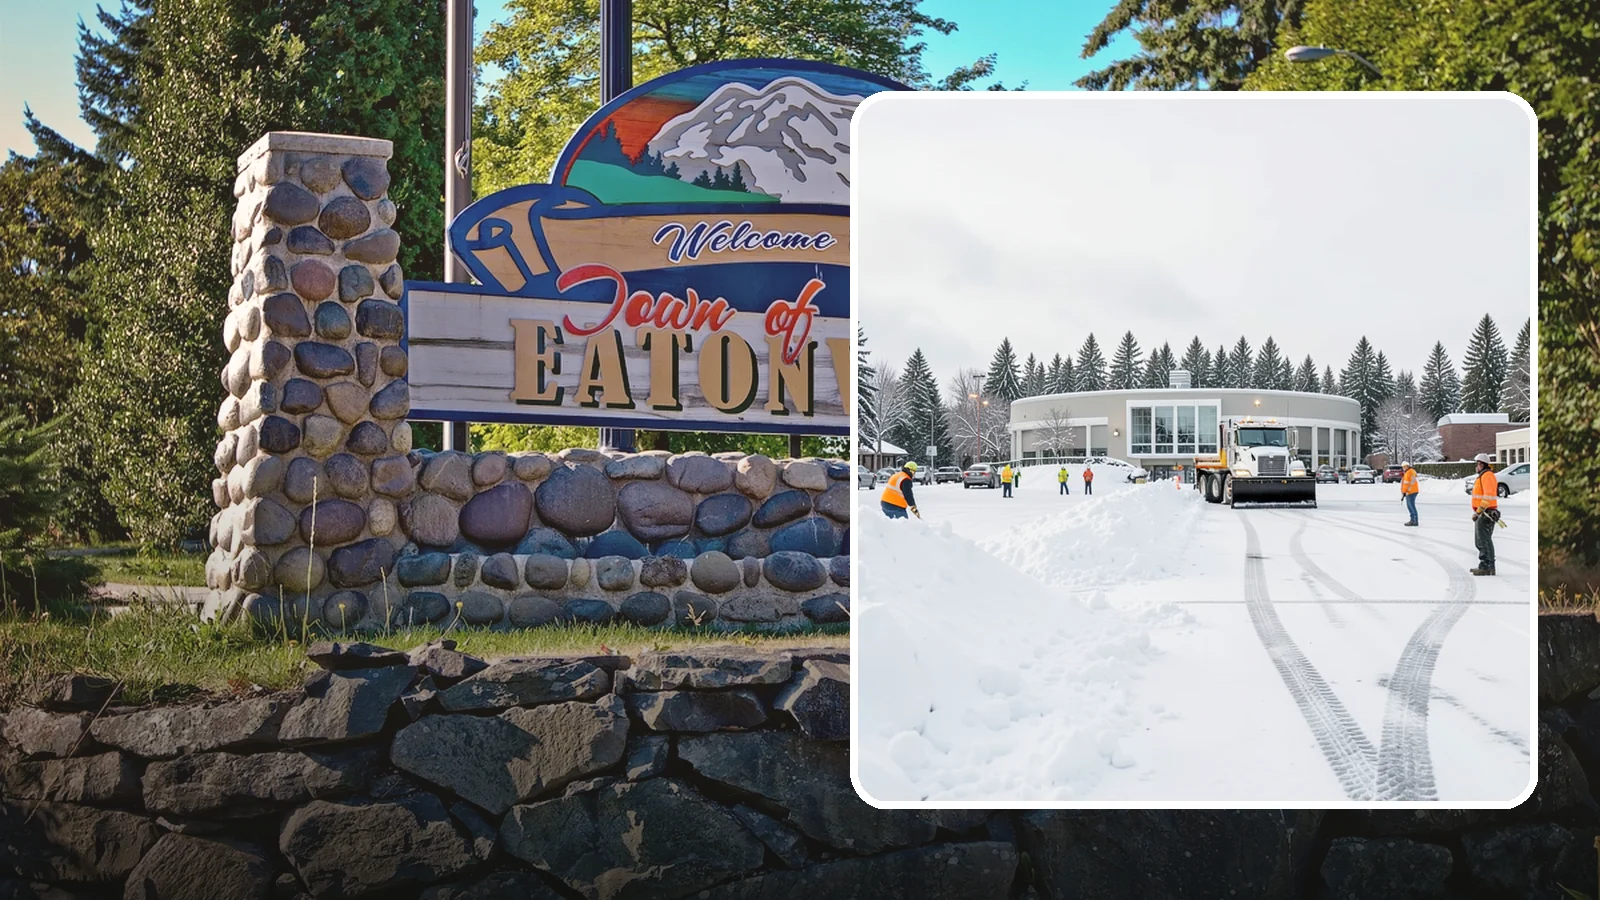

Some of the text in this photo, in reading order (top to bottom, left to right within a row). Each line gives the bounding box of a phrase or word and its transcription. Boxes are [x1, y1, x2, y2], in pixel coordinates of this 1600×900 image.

[654, 221, 837, 263] Welcome
[557, 263, 826, 365] Town of
